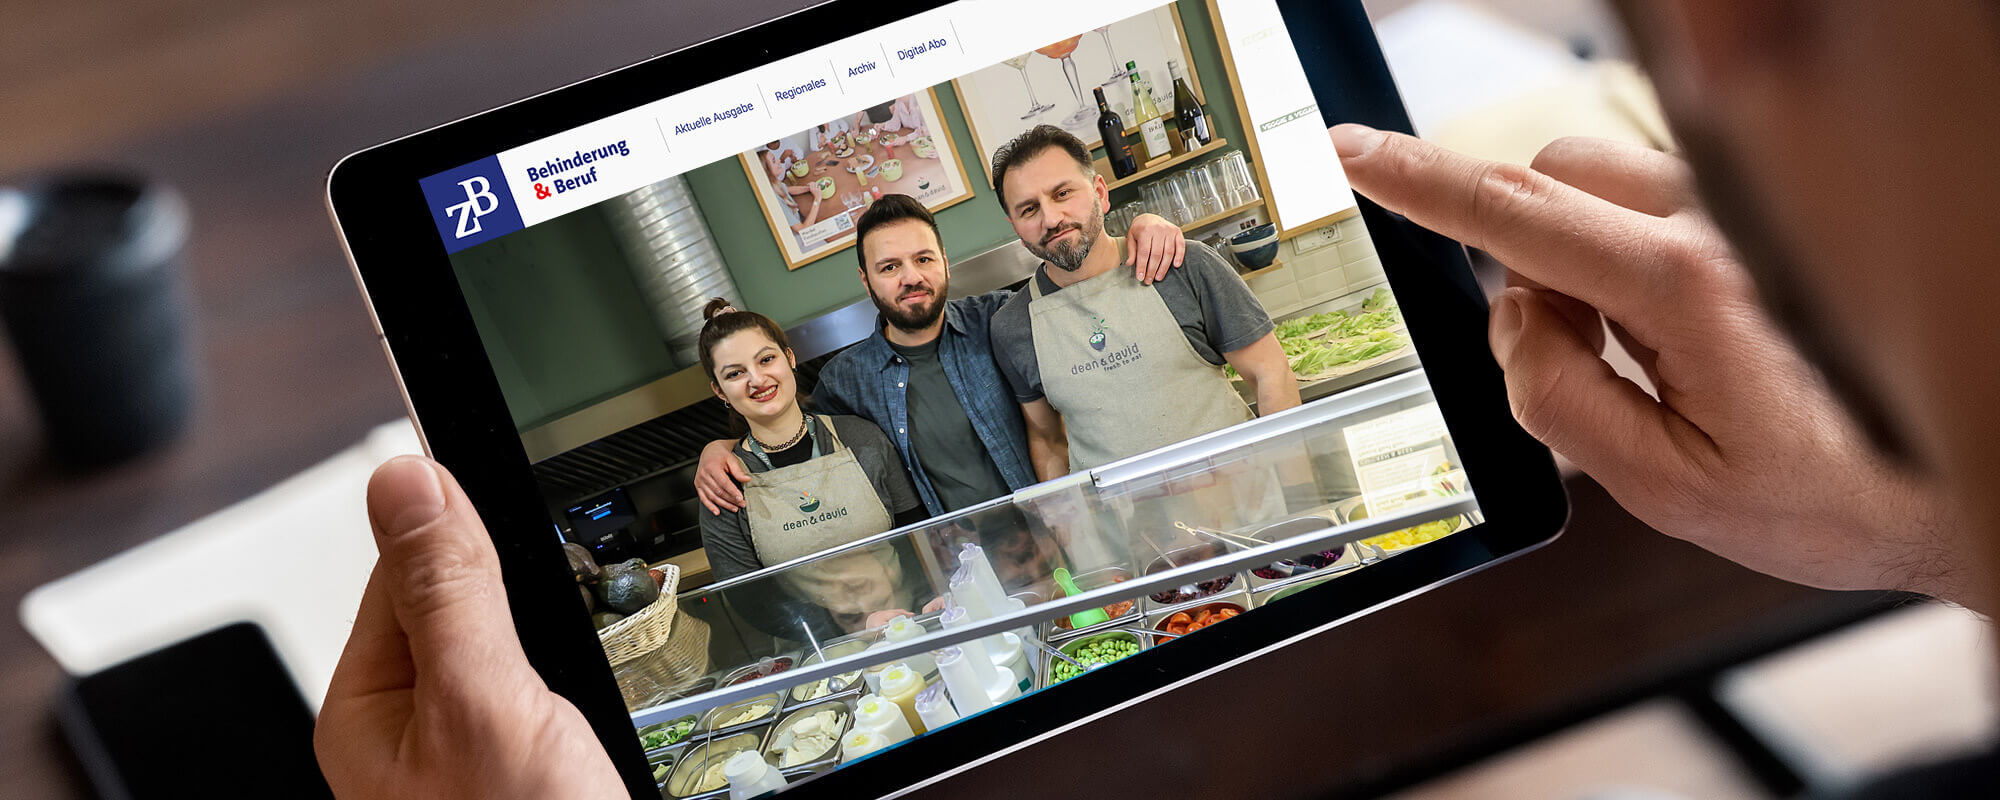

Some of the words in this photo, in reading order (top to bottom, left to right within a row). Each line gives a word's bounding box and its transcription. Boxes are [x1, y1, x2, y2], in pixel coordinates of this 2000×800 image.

[897, 43, 928, 61] Digital
[928, 38, 947, 51] Abo
[848, 60, 876, 77] Archiv
[775, 78, 827, 101] Regionales
[674, 116, 712, 136] Aktuelle
[713, 102, 754, 123] Ausgabe
[526, 139, 630, 182] Behinderung
[533, 182, 552, 200] &
[554, 167, 598, 194] Beruf
